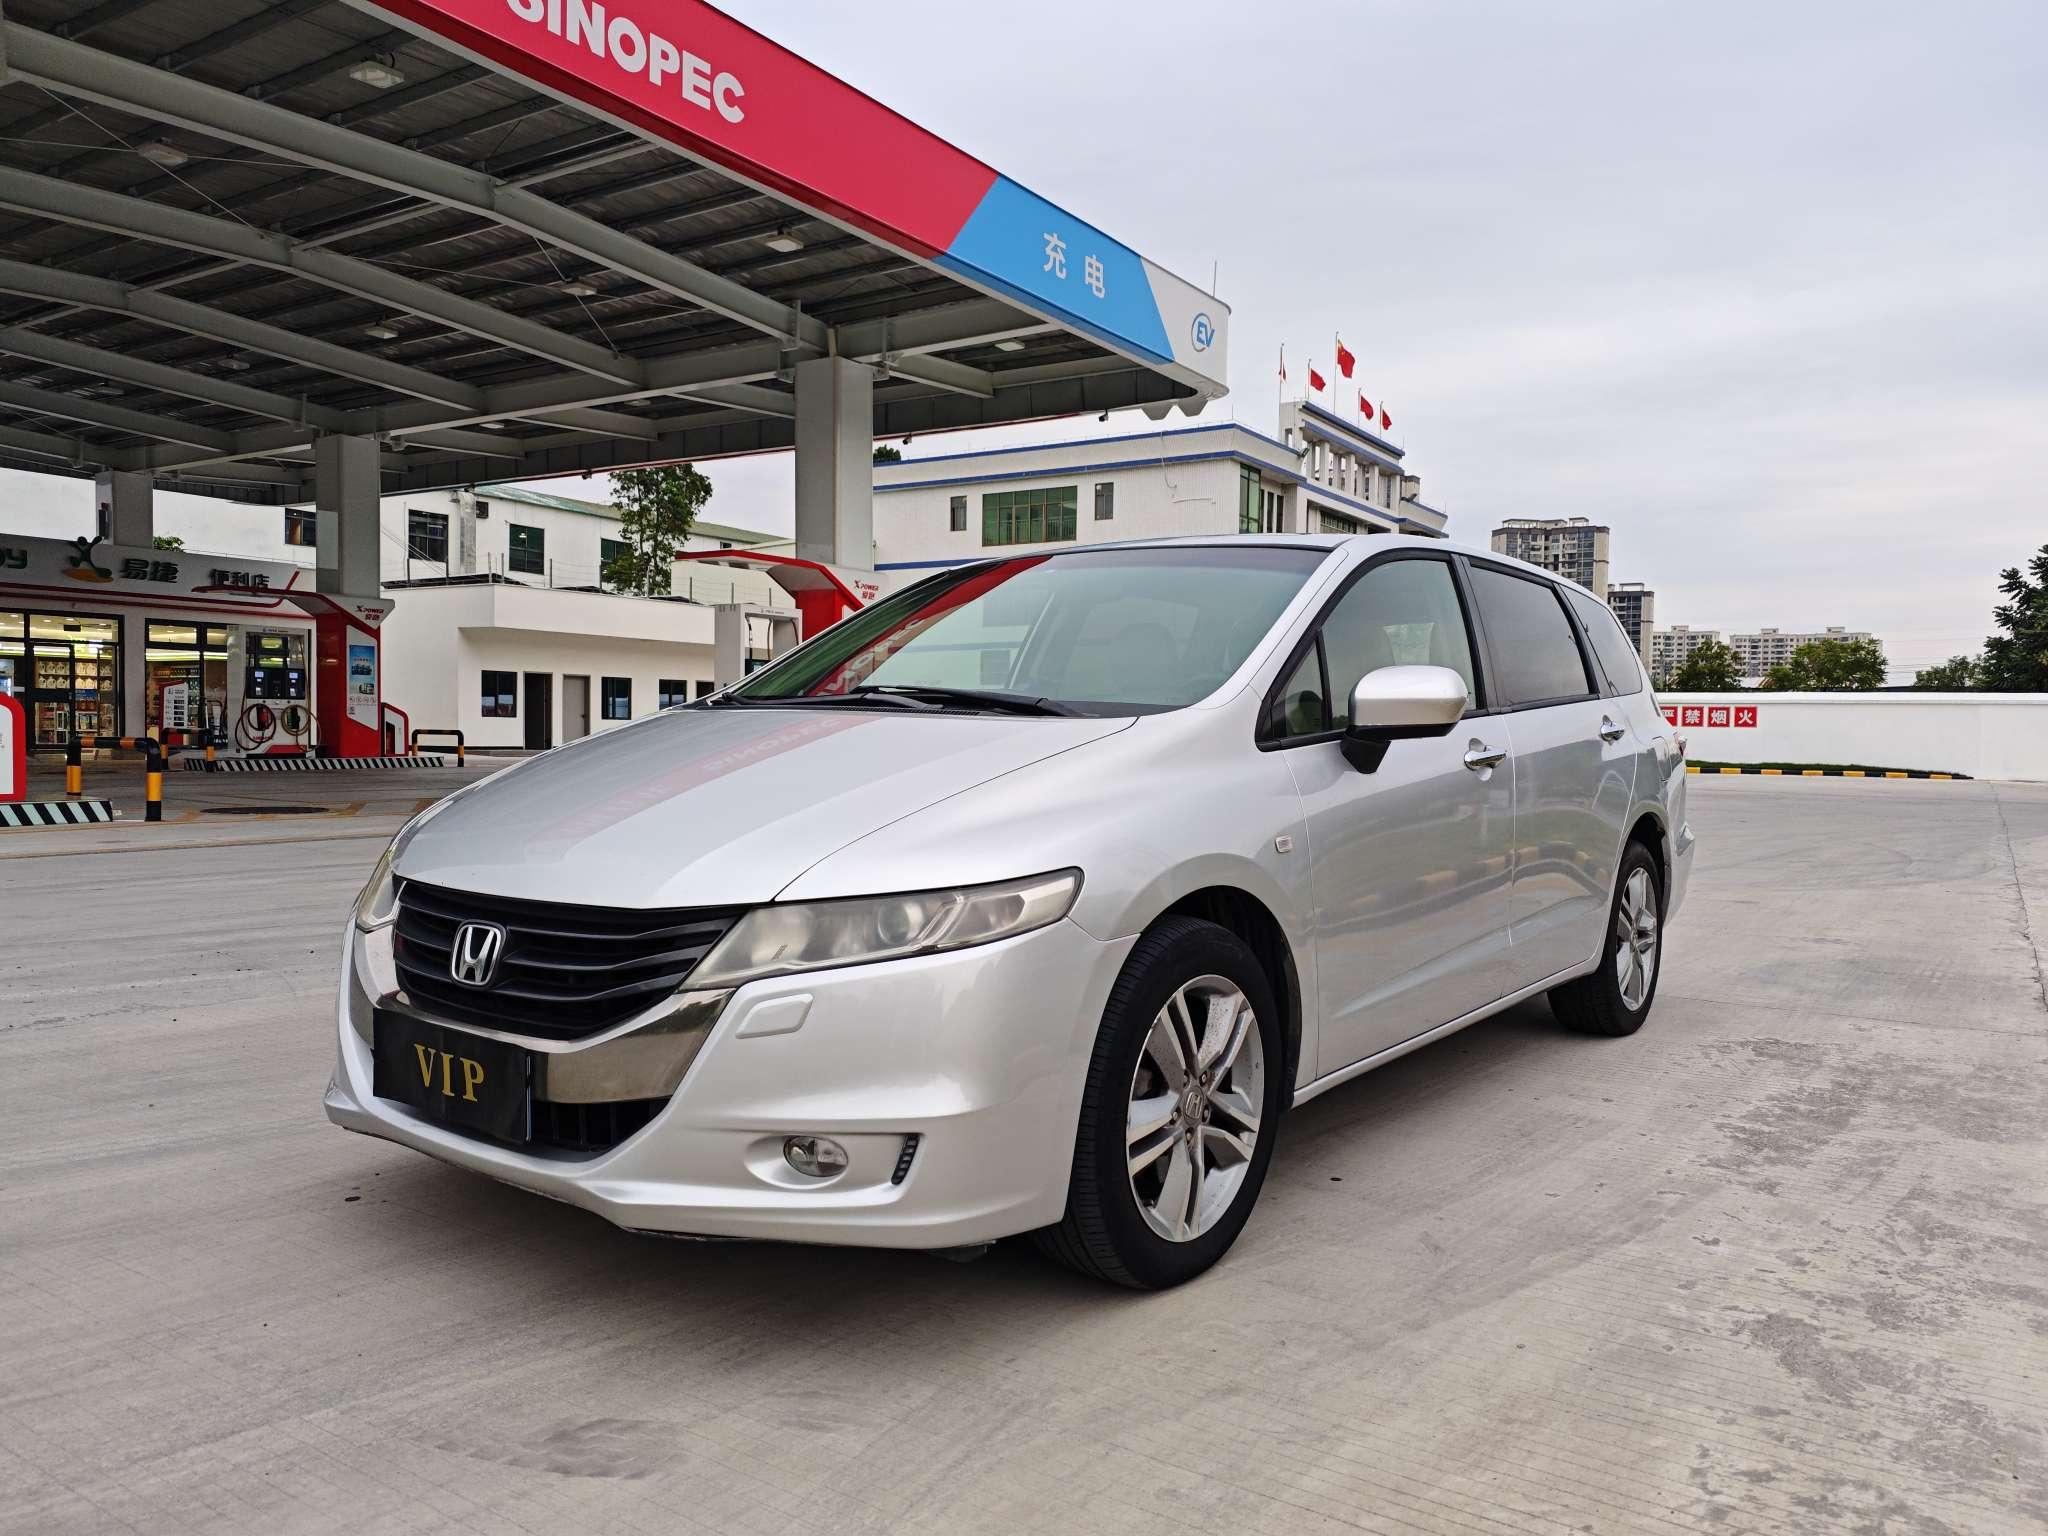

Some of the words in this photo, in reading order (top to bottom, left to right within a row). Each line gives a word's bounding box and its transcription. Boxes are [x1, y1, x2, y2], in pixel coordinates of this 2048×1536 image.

[1043, 232, 1105, 298] 充电
[1196, 321, 1215, 347] EV
[118, 559, 178, 583] 易捷
[414, 1043, 485, 1102] VIP
